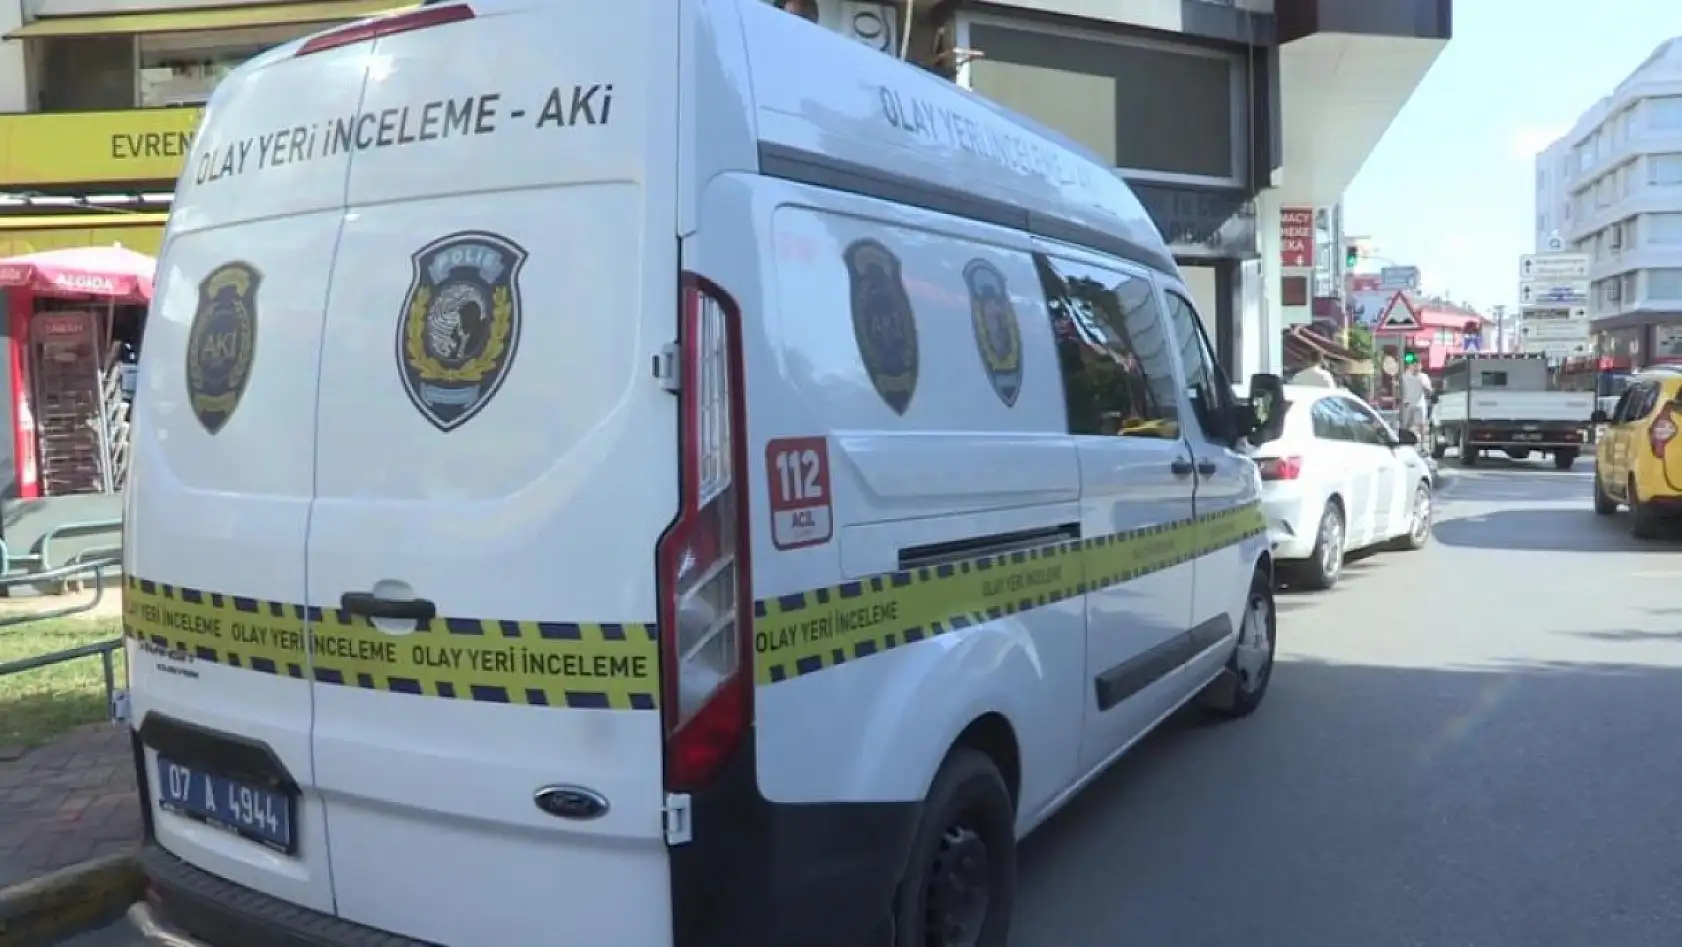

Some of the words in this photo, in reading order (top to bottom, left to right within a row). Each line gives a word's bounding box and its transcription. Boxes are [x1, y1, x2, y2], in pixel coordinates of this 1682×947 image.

[879, 85, 938, 140] OLAY
[111, 130, 195, 159] EVREN
[196, 137, 253, 185] OLAY
[775, 449, 823, 502] 112
[231, 621, 268, 646] OLAY
[412, 645, 462, 668] OLAY
[468, 646, 516, 673] YERİ
[522, 647, 648, 679] İNCELEME
[756, 621, 798, 653] OLAY
[168, 763, 191, 802] 07
[205, 774, 217, 813] A
[228, 783, 279, 835] 4944
